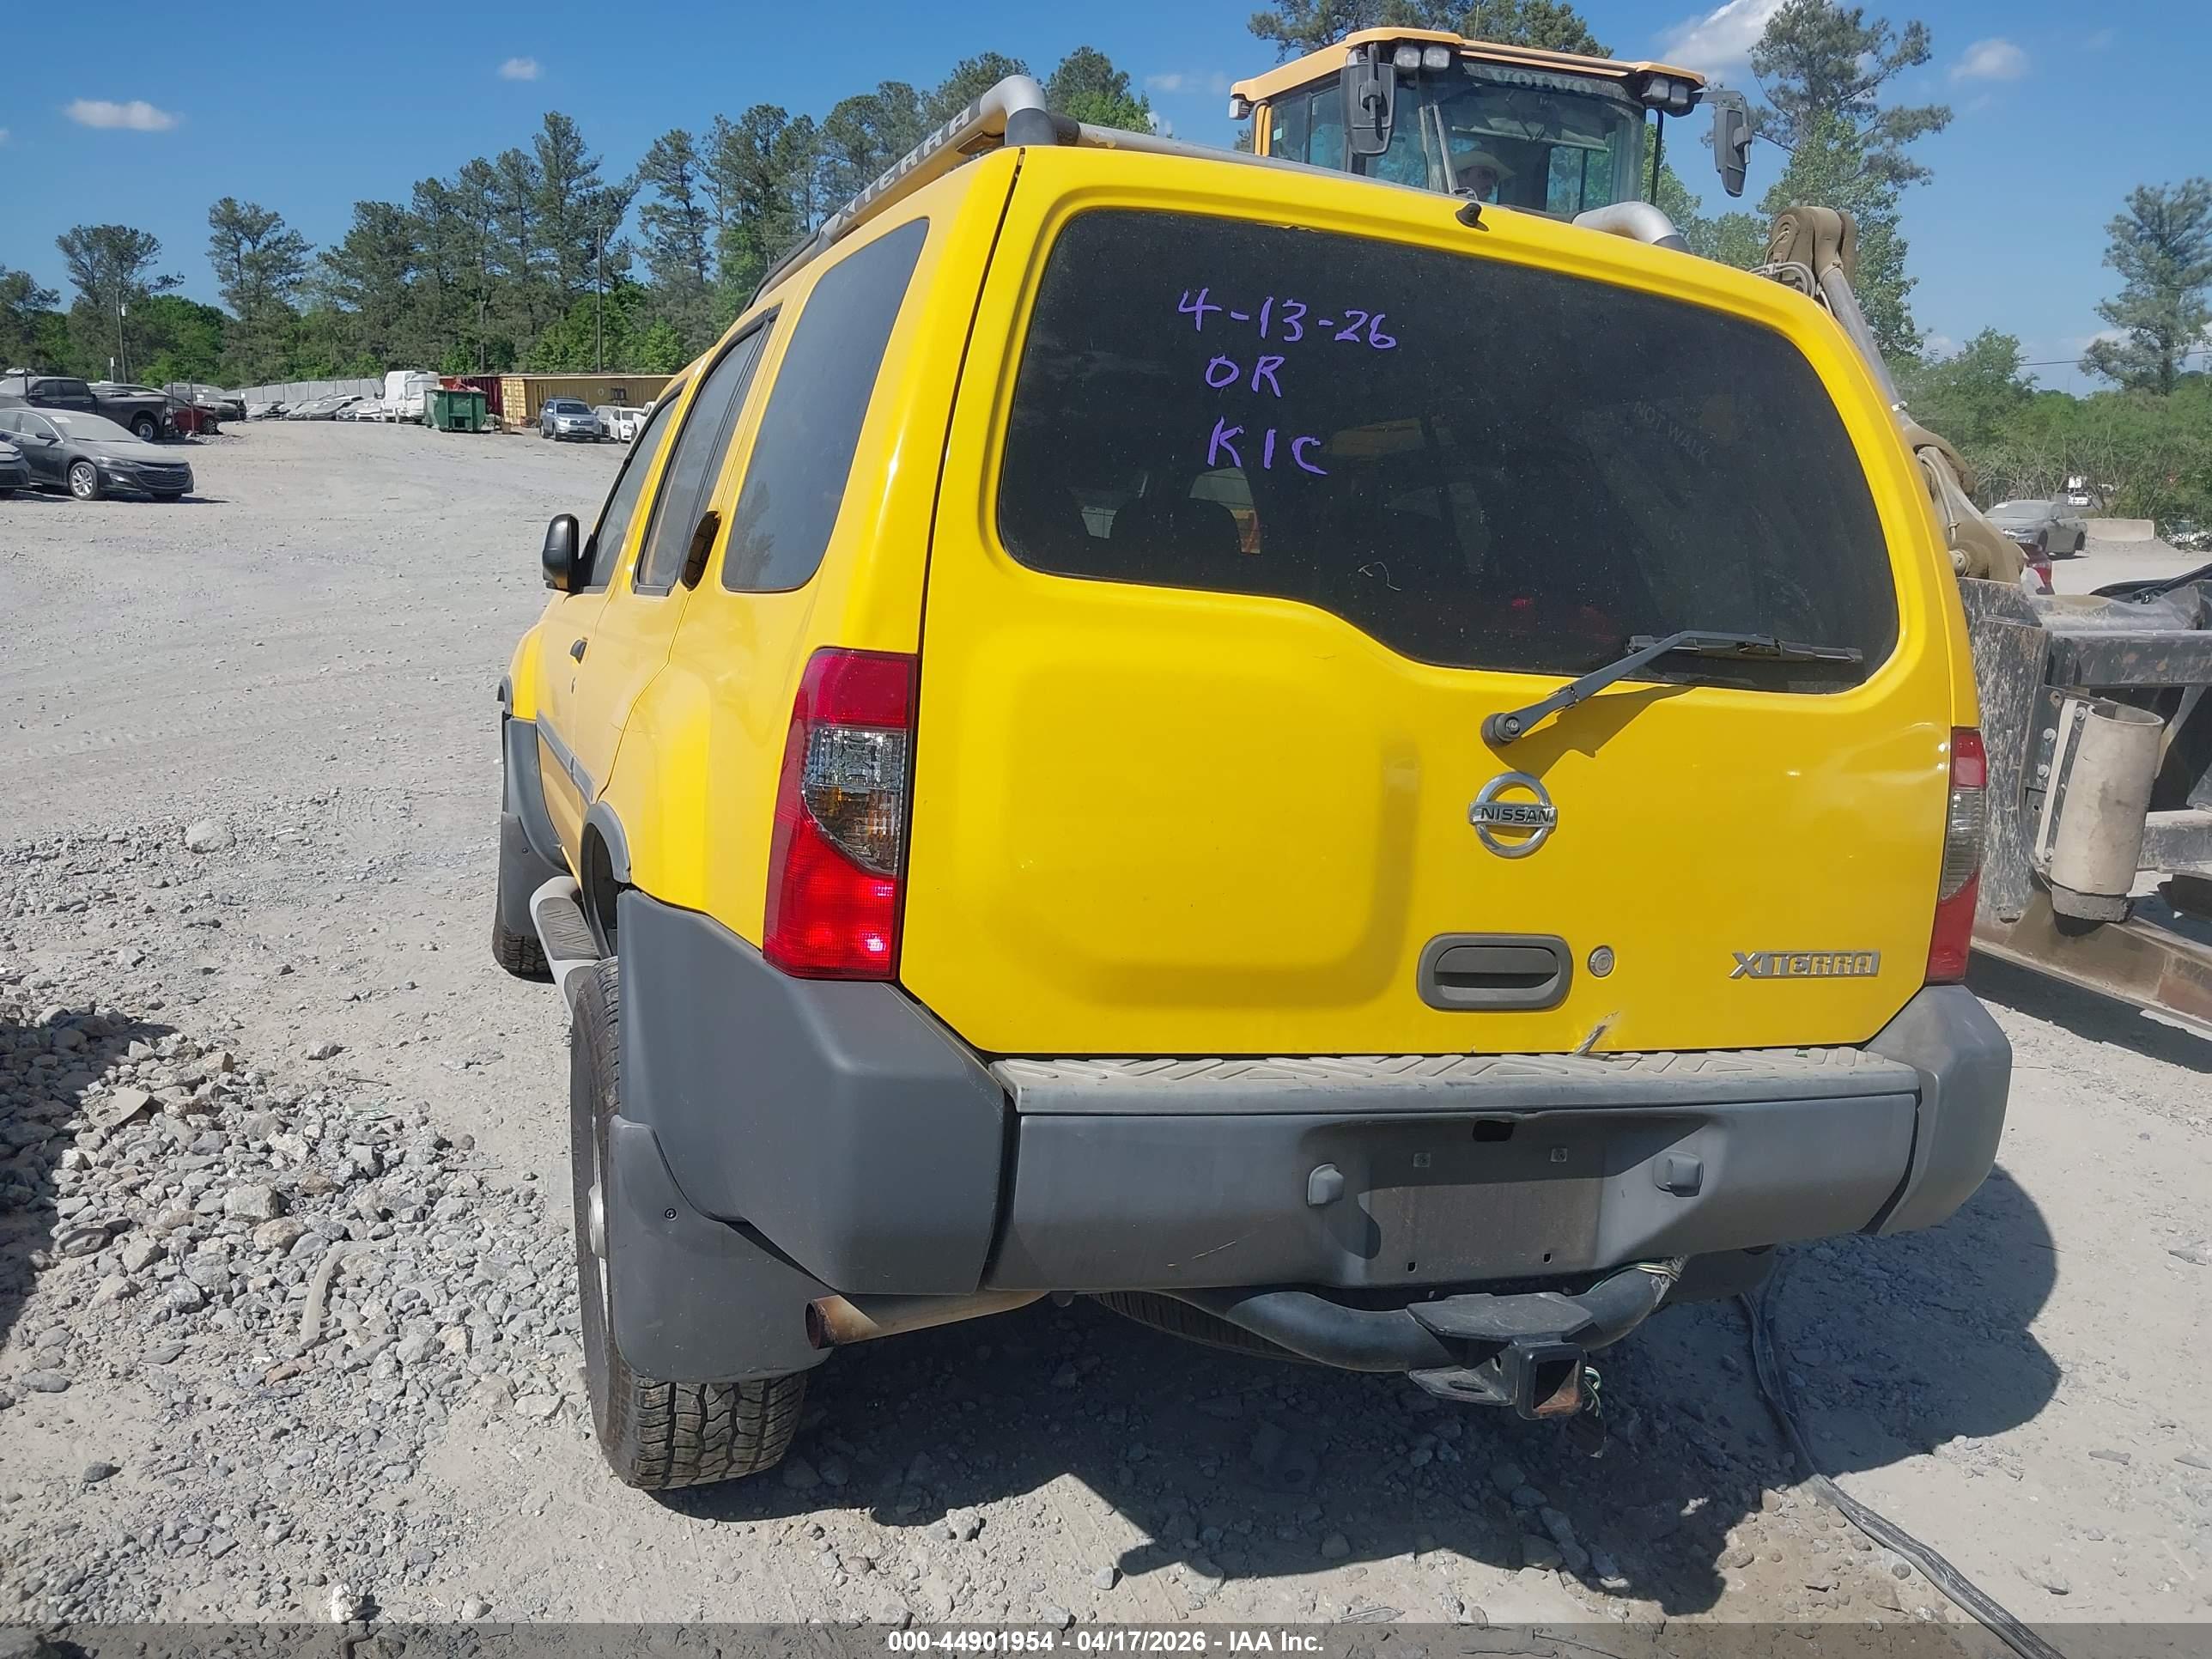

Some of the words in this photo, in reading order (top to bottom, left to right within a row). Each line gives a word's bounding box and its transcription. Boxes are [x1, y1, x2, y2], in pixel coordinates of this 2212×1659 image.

[1486, 68, 1593, 95] VOLVO
[836, 106, 971, 228] XTERRA
[1177, 287, 1397, 349] 4-13-26
[1204, 353, 1285, 398] OR
[1480, 807, 1551, 823] NISSAN
[1729, 950, 1881, 979] XTERRA
